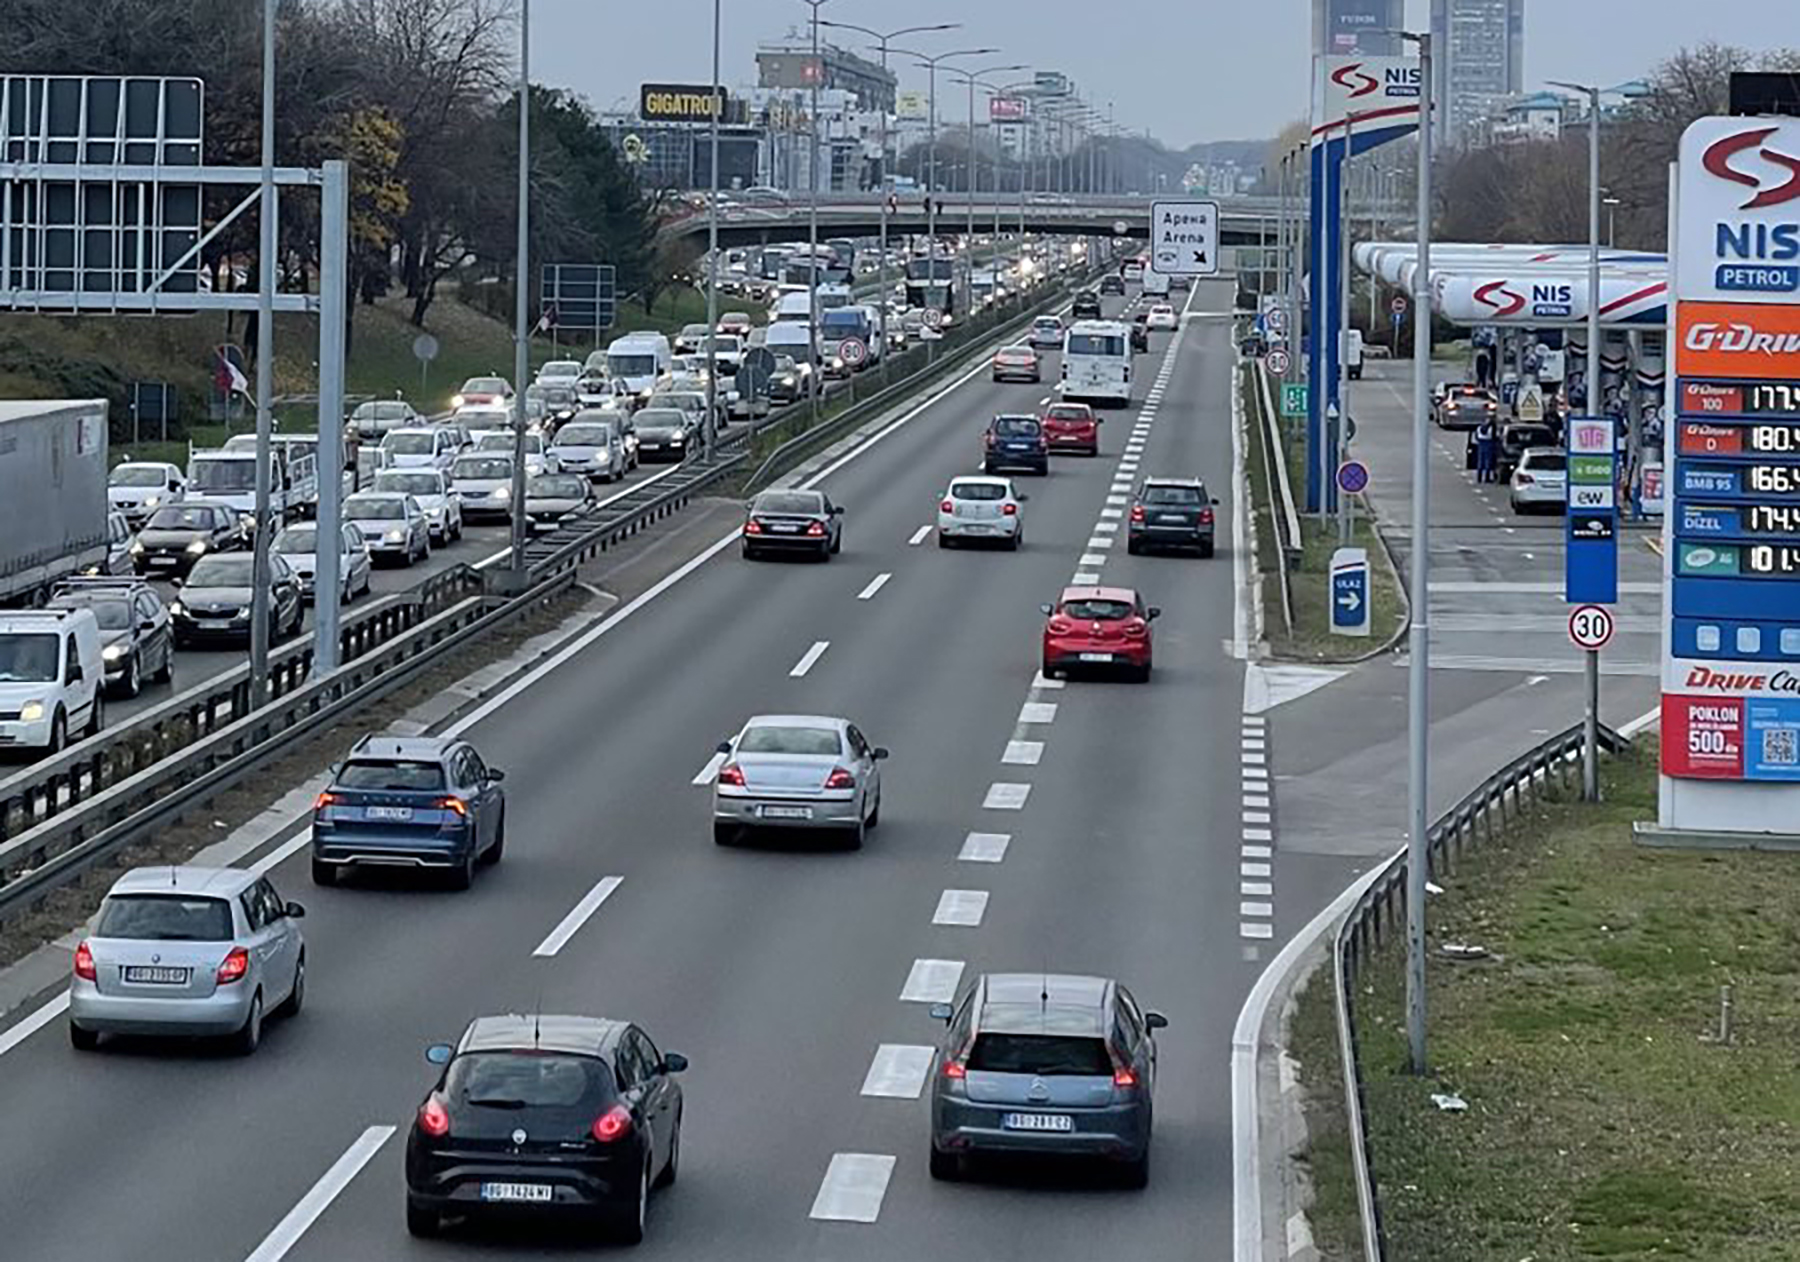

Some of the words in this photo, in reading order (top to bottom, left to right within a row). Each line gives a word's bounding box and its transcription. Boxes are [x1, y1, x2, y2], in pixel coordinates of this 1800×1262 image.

[1385, 68, 1421, 84] NIS
[1163, 212, 1207, 227] Арена
[1163, 230, 1205, 243] Arena
[1716, 223, 1800, 259] NIS
[1723, 269, 1793, 285] PETROL
[1532, 284, 1571, 302] NIS
[1702, 397, 1723, 410] 100
[1685, 478, 1715, 489] BMB
[1717, 478, 1732, 490] 95
[1684, 518, 1722, 529] DIZEL
[1577, 614, 1605, 638] 30
[1686, 666, 1767, 692] DRIVE
[1769, 670, 1800, 695] Ca
[1688, 706, 1739, 722] POKLON
[1688, 731, 1725, 754] 500
